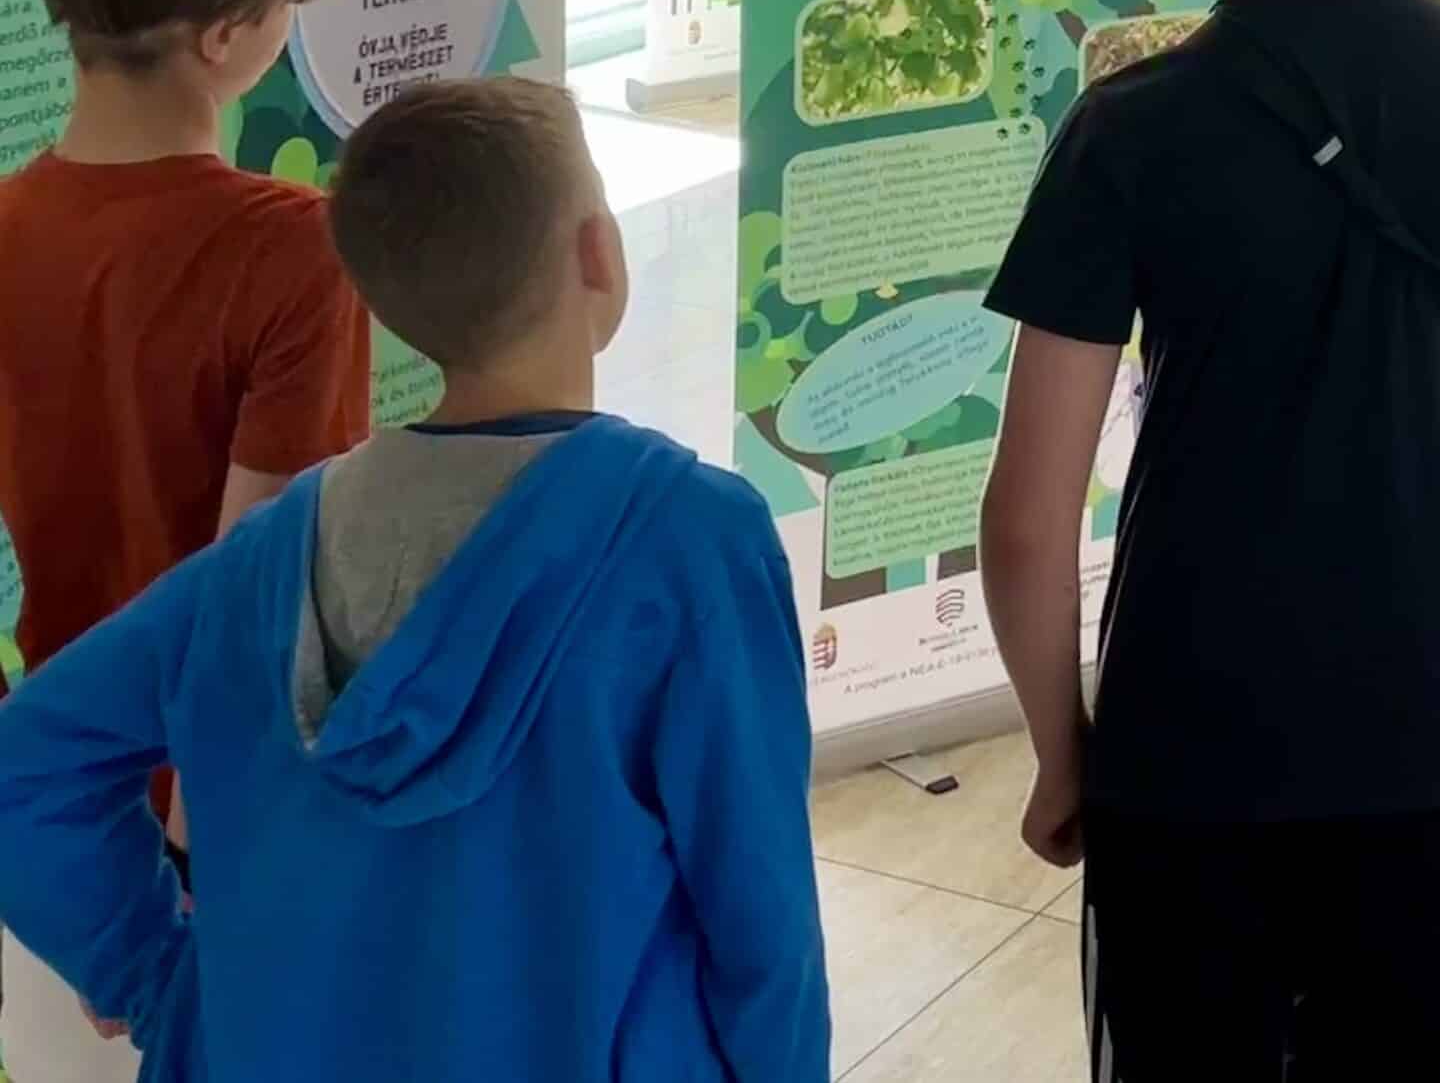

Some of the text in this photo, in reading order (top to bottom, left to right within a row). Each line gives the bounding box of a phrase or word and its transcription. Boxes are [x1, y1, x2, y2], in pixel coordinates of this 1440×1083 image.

[400, 23, 447, 50] VÉDJE
[353, 45, 454, 84] A TERMÉSZET
